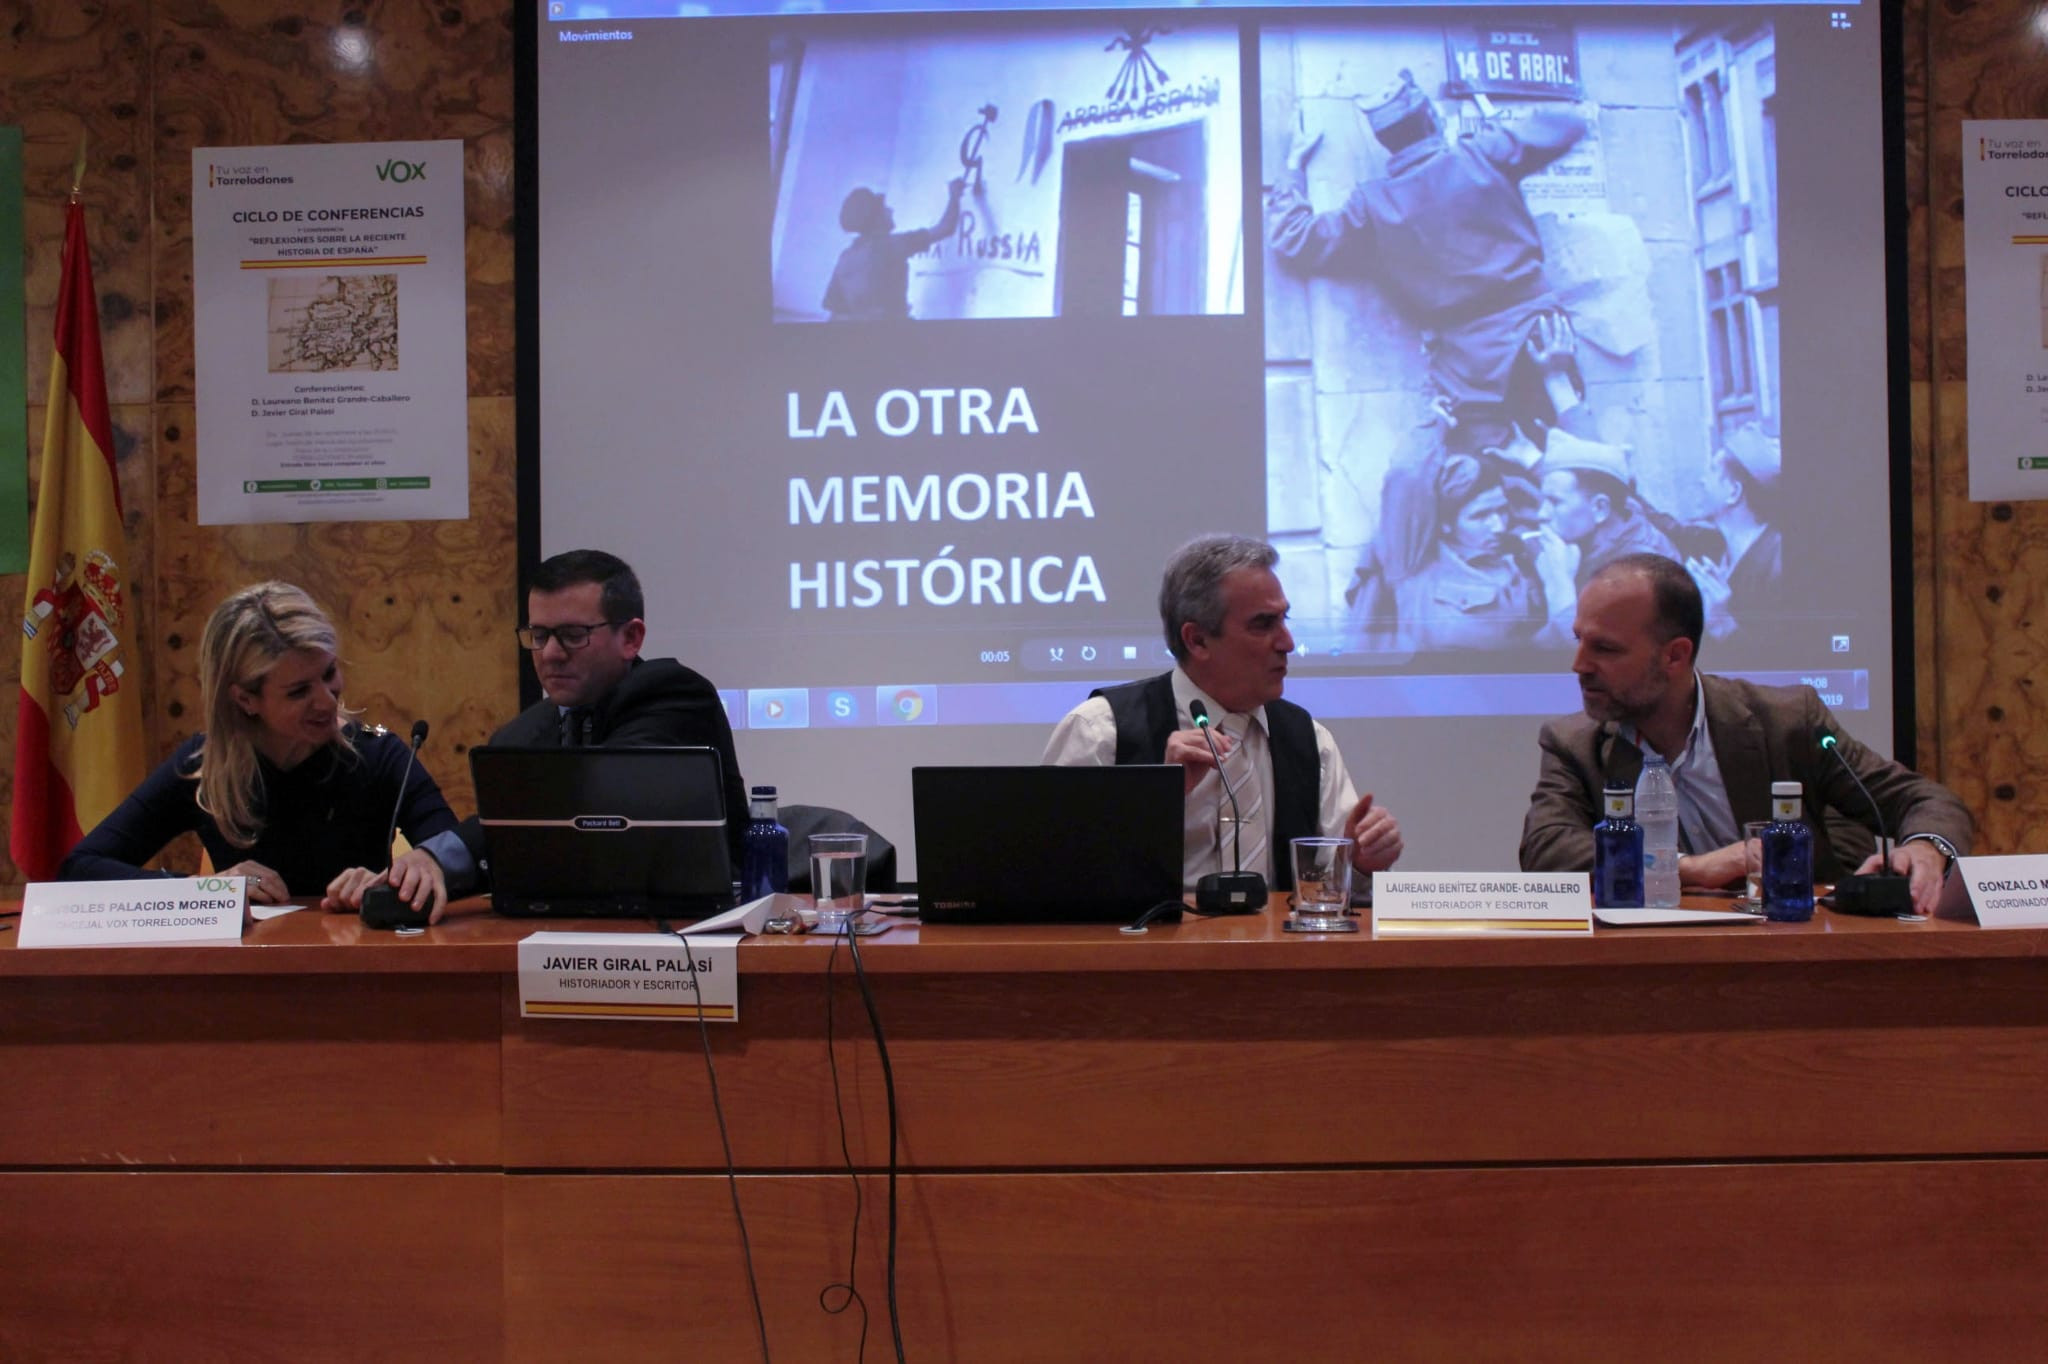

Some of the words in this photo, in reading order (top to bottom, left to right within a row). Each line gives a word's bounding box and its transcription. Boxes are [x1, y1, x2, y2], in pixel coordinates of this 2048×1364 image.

[559, 29, 633, 42] Movimientos
[1490, 32, 1539, 45] DEL
[1456, 51, 1479, 80] 14
[1485, 51, 1514, 80] DE
[2004, 140, 2024, 148] voz
[216, 165, 230, 175] Tu
[232, 166, 251, 175] voz
[253, 165, 269, 174] en
[375, 158, 427, 184] VOX
[216, 175, 294, 186] Torrelodones
[232, 210, 279, 224] CICLO
[282, 209, 304, 222] DE
[307, 206, 425, 222] CONFERENCIAS
[317, 234, 347, 244] SOBRE
[349, 234, 362, 243] LA
[277, 247, 320, 257] HISTORIA
[322, 246, 336, 256] DE
[788, 390, 858, 438] LA
[875, 387, 1040, 437] OTRA
[788, 471, 1096, 525] MEMORIA
[790, 544, 1107, 609] HISTÓRICA
[980, 650, 1010, 662] 00:05
[196, 877, 235, 892] VOX
[1386, 882, 1436, 893] LAUREANO
[1439, 880, 1478, 893] BENÍTEZ
[1479, 882, 1522, 893] GRANDE-
[1524, 882, 1581, 894] CABALLERO
[1977, 880, 2038, 892] GONZALO
[109, 900, 175, 913] PALACIOS
[179, 899, 237, 910] MORENO
[1411, 901, 1482, 910] HISTORIADOR
[1485, 901, 1492, 909] Y
[1495, 901, 1549, 910] ESCRITOR
[106, 918, 128, 929] VOX
[132, 916, 218, 928] TORRELODONES
[543, 957, 598, 971] JAVIER
[603, 958, 651, 972] GIRAL
[656, 957, 713, 972] PALASÍ
[559, 978, 631, 989] HISTORIADOR
[633, 979, 640, 989] Y
[643, 980, 697, 991] ESCRITOR
